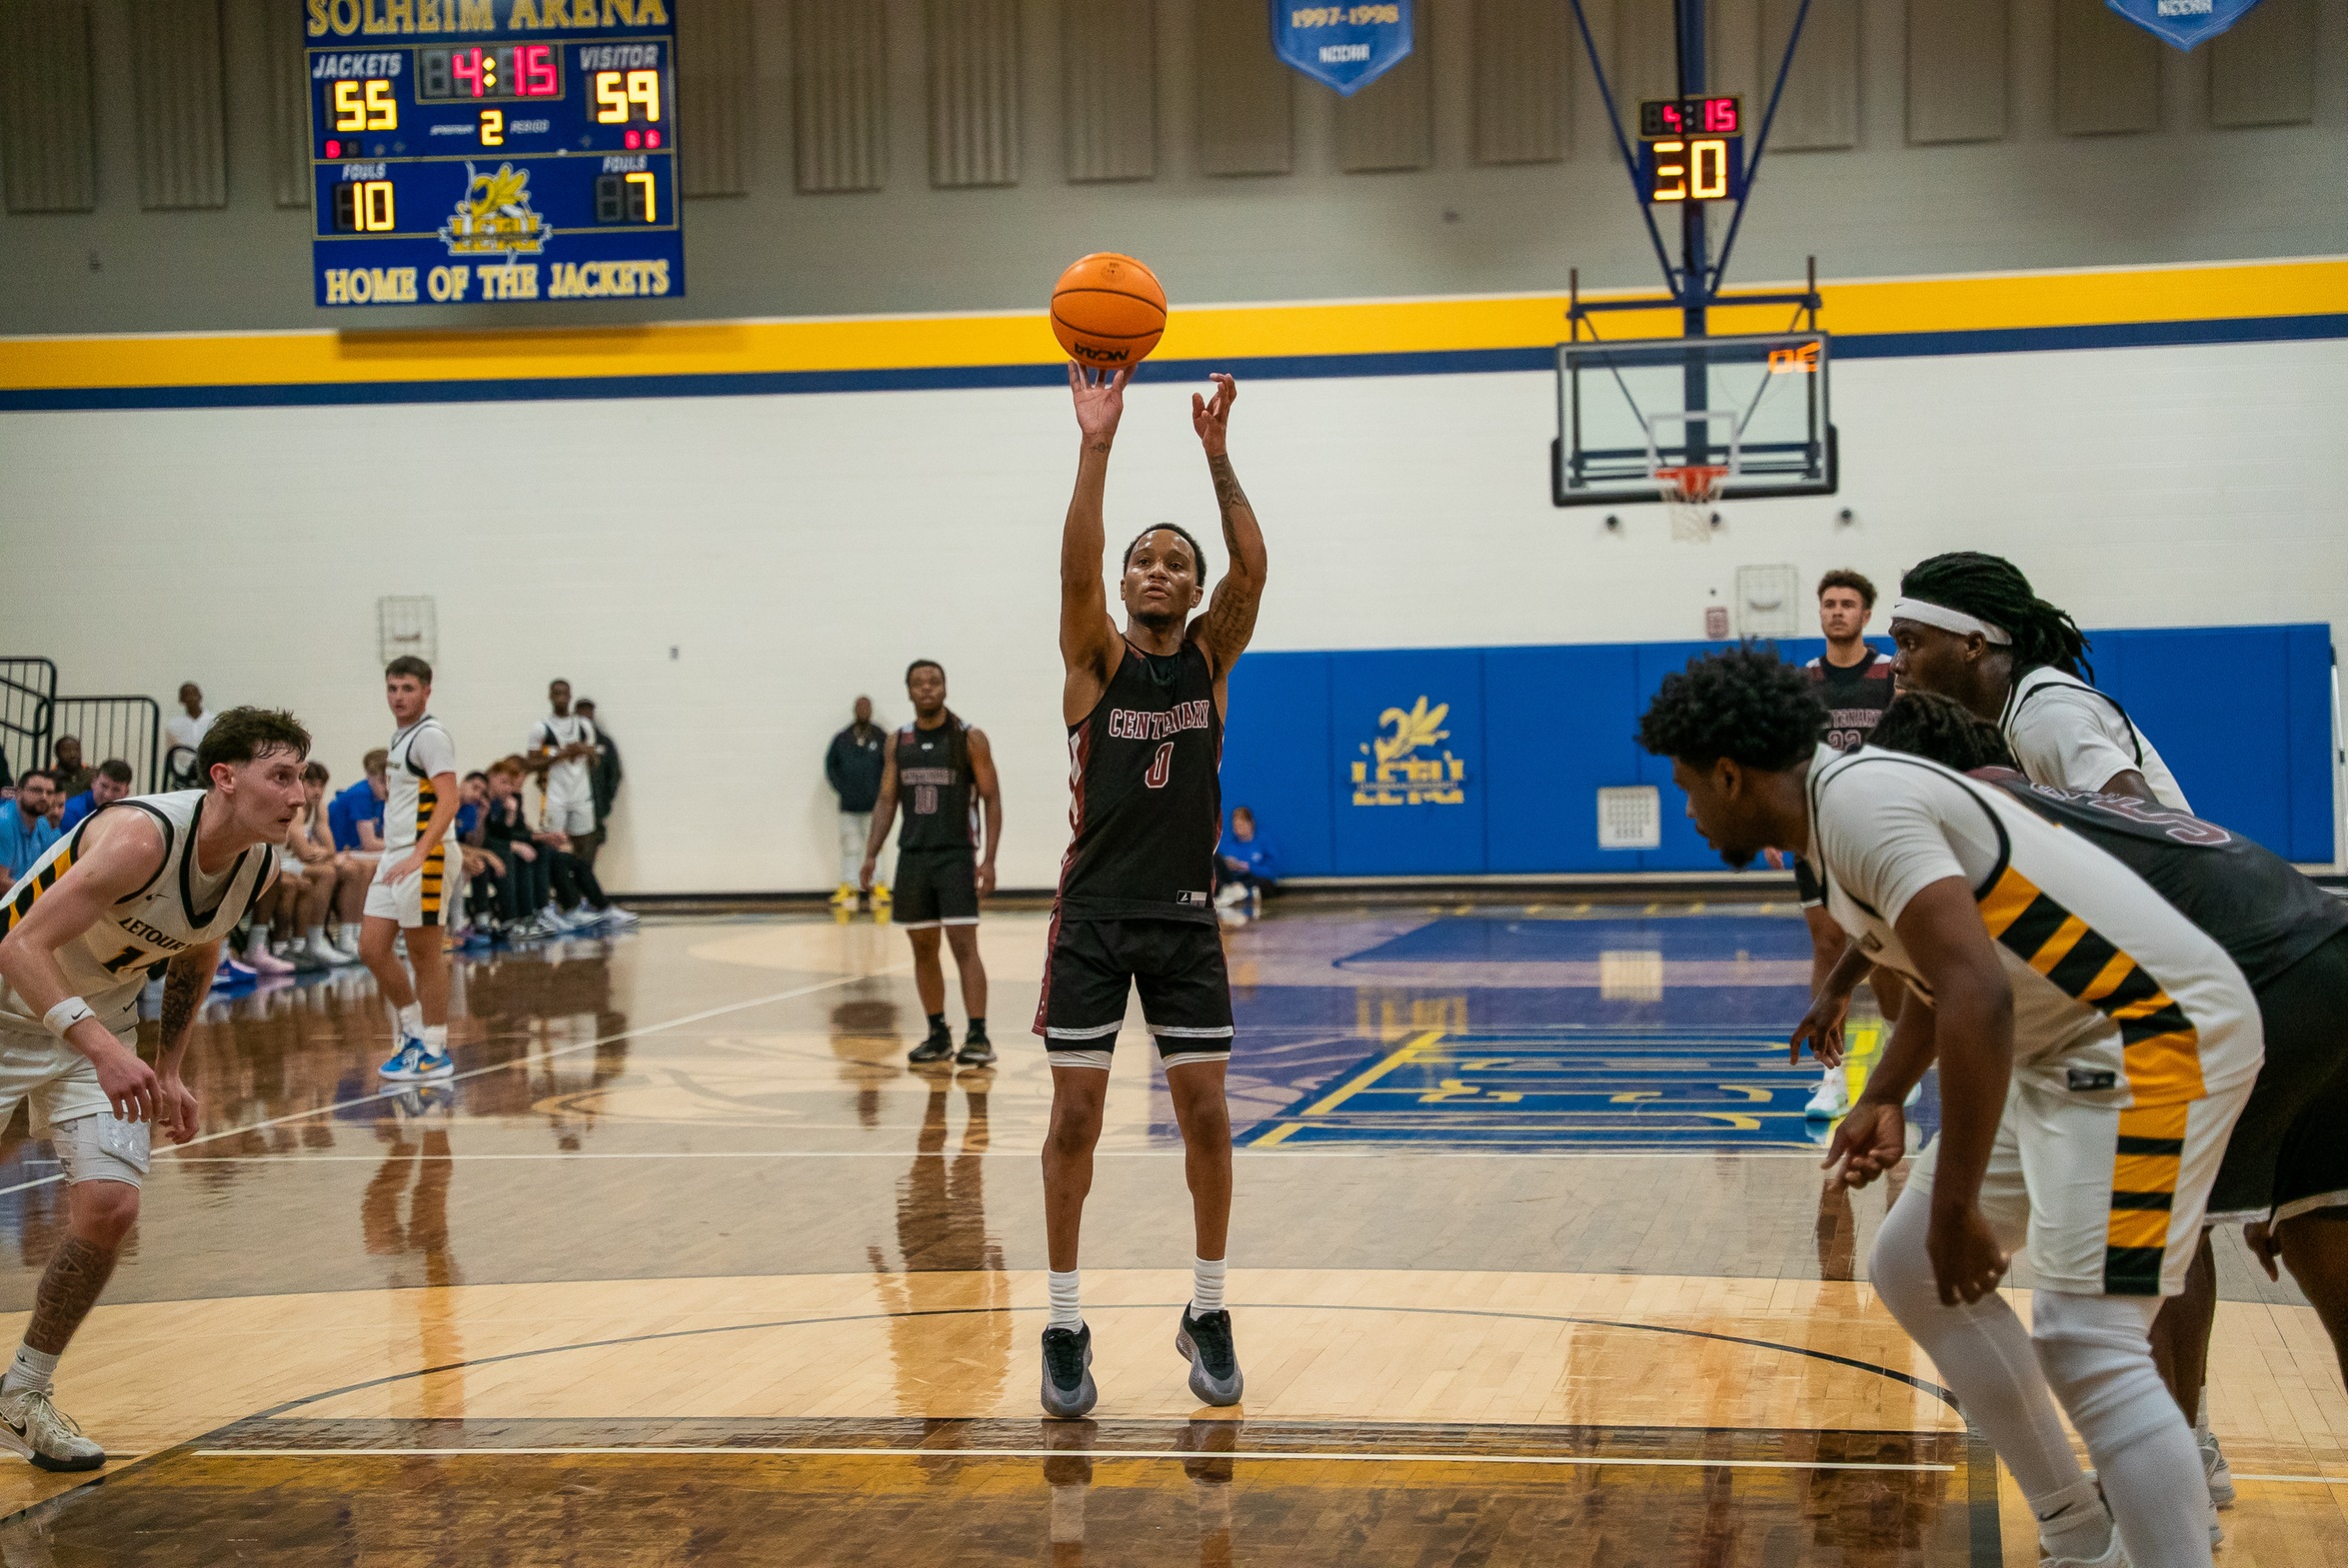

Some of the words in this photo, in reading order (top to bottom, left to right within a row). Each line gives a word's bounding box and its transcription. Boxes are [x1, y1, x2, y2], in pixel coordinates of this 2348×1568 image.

[306, 0, 496, 37] SOLHEIM
[508, 0, 670, 30] ARENA
[312, 52, 403, 79] JACKETS
[453, 45, 557, 97] 4:15
[580, 44, 659, 71] VISITOR
[334, 79, 399, 132] 55
[596, 69, 661, 124] 59
[480, 109, 504, 146] 2
[342, 163, 387, 181] FOULS
[602, 155, 648, 173] FOULS
[1652, 140, 1727, 201] 30
[353, 181, 395, 232] 10
[624, 171, 656, 223] 7
[325, 267, 418, 304] HOME
[427, 265, 470, 302] OF
[477, 263, 539, 300] THE
[548, 259, 671, 299] JACKETS
[1109, 700, 1209, 740] CENTENARY
[1145, 742, 1174, 788] 0
[118, 916, 193, 951] LETOUR
